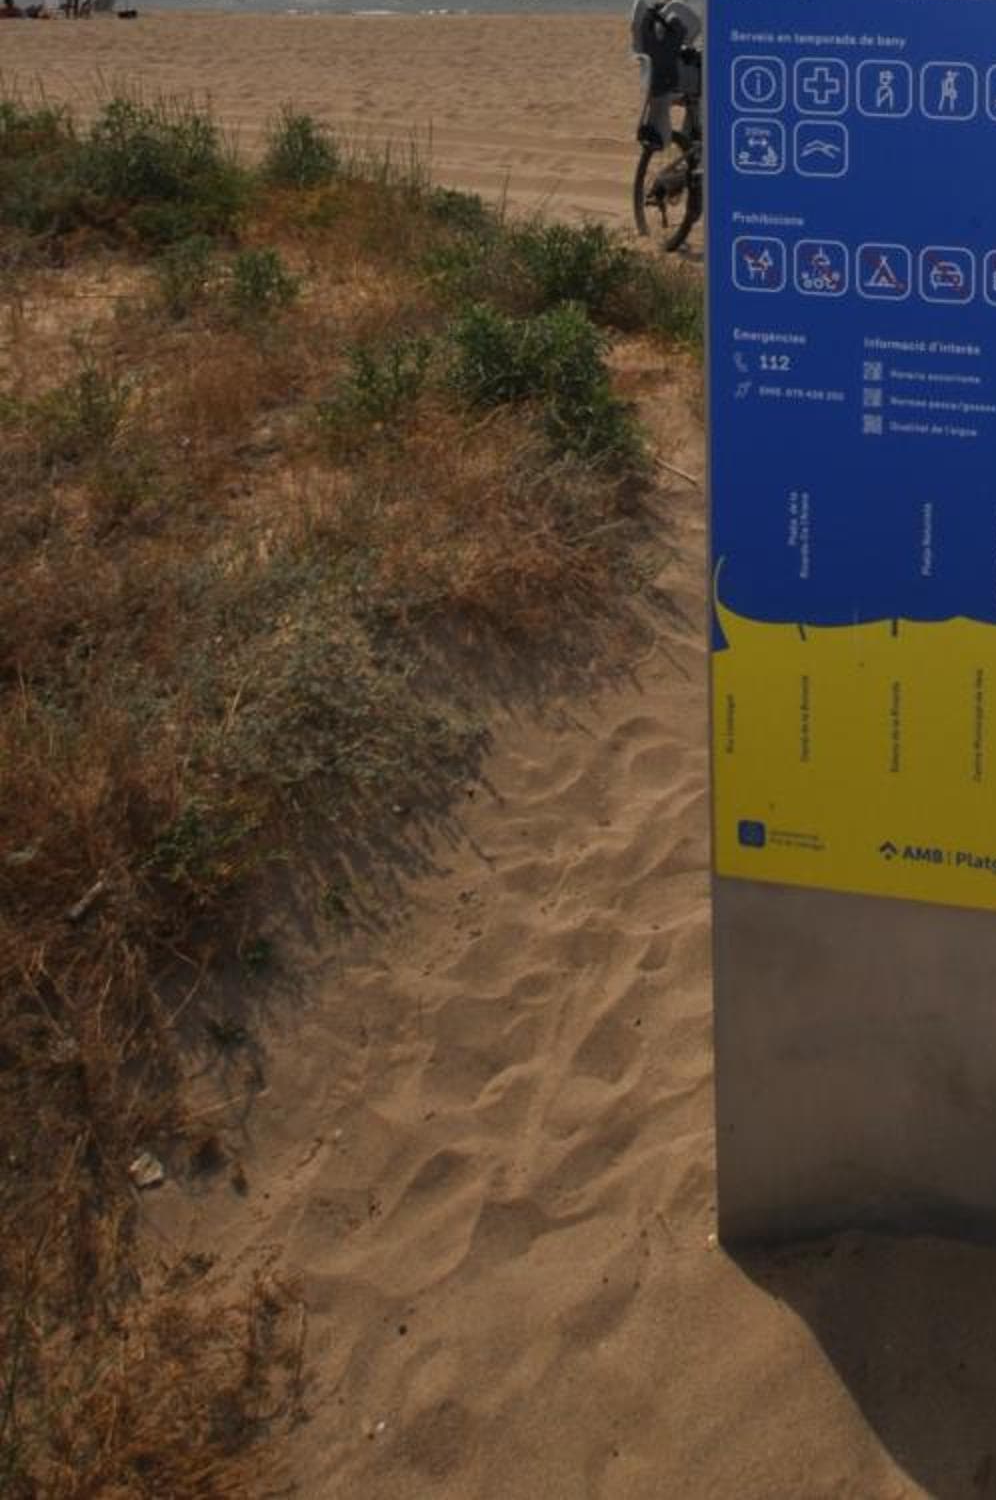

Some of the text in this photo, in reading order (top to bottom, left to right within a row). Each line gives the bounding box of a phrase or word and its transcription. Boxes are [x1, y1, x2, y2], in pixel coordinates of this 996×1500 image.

[730, 30, 908, 50] Serveis en temporada de bany
[732, 210, 805, 227] Prohibicions
[759, 353, 791, 371] 112
[902, 845, 943, 865] AMB
